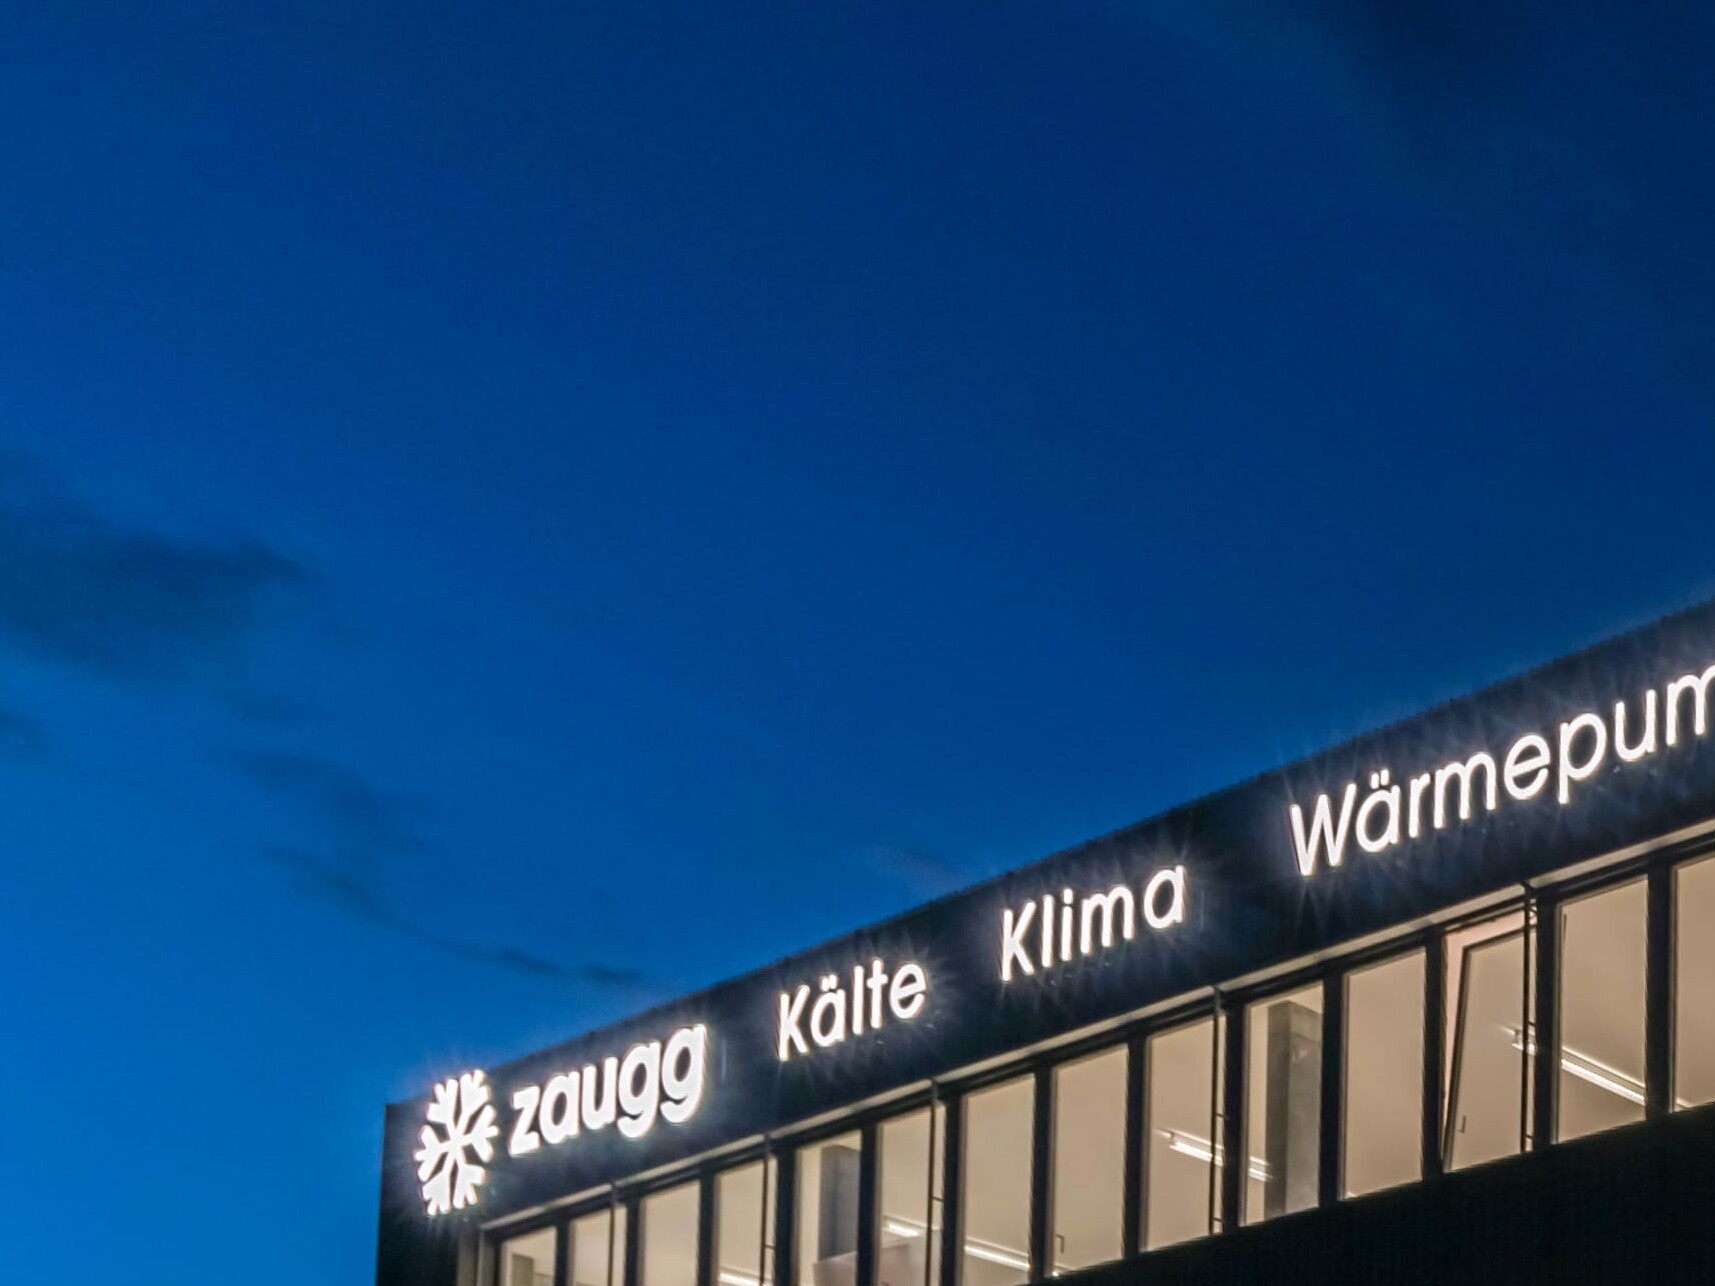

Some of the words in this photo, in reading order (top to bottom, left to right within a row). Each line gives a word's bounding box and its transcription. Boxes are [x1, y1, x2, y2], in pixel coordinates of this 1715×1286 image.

[778, 956, 927, 1062] Kälte
[1000, 864, 1186, 982] Klima
[507, 1022, 708, 1158] zaugg
